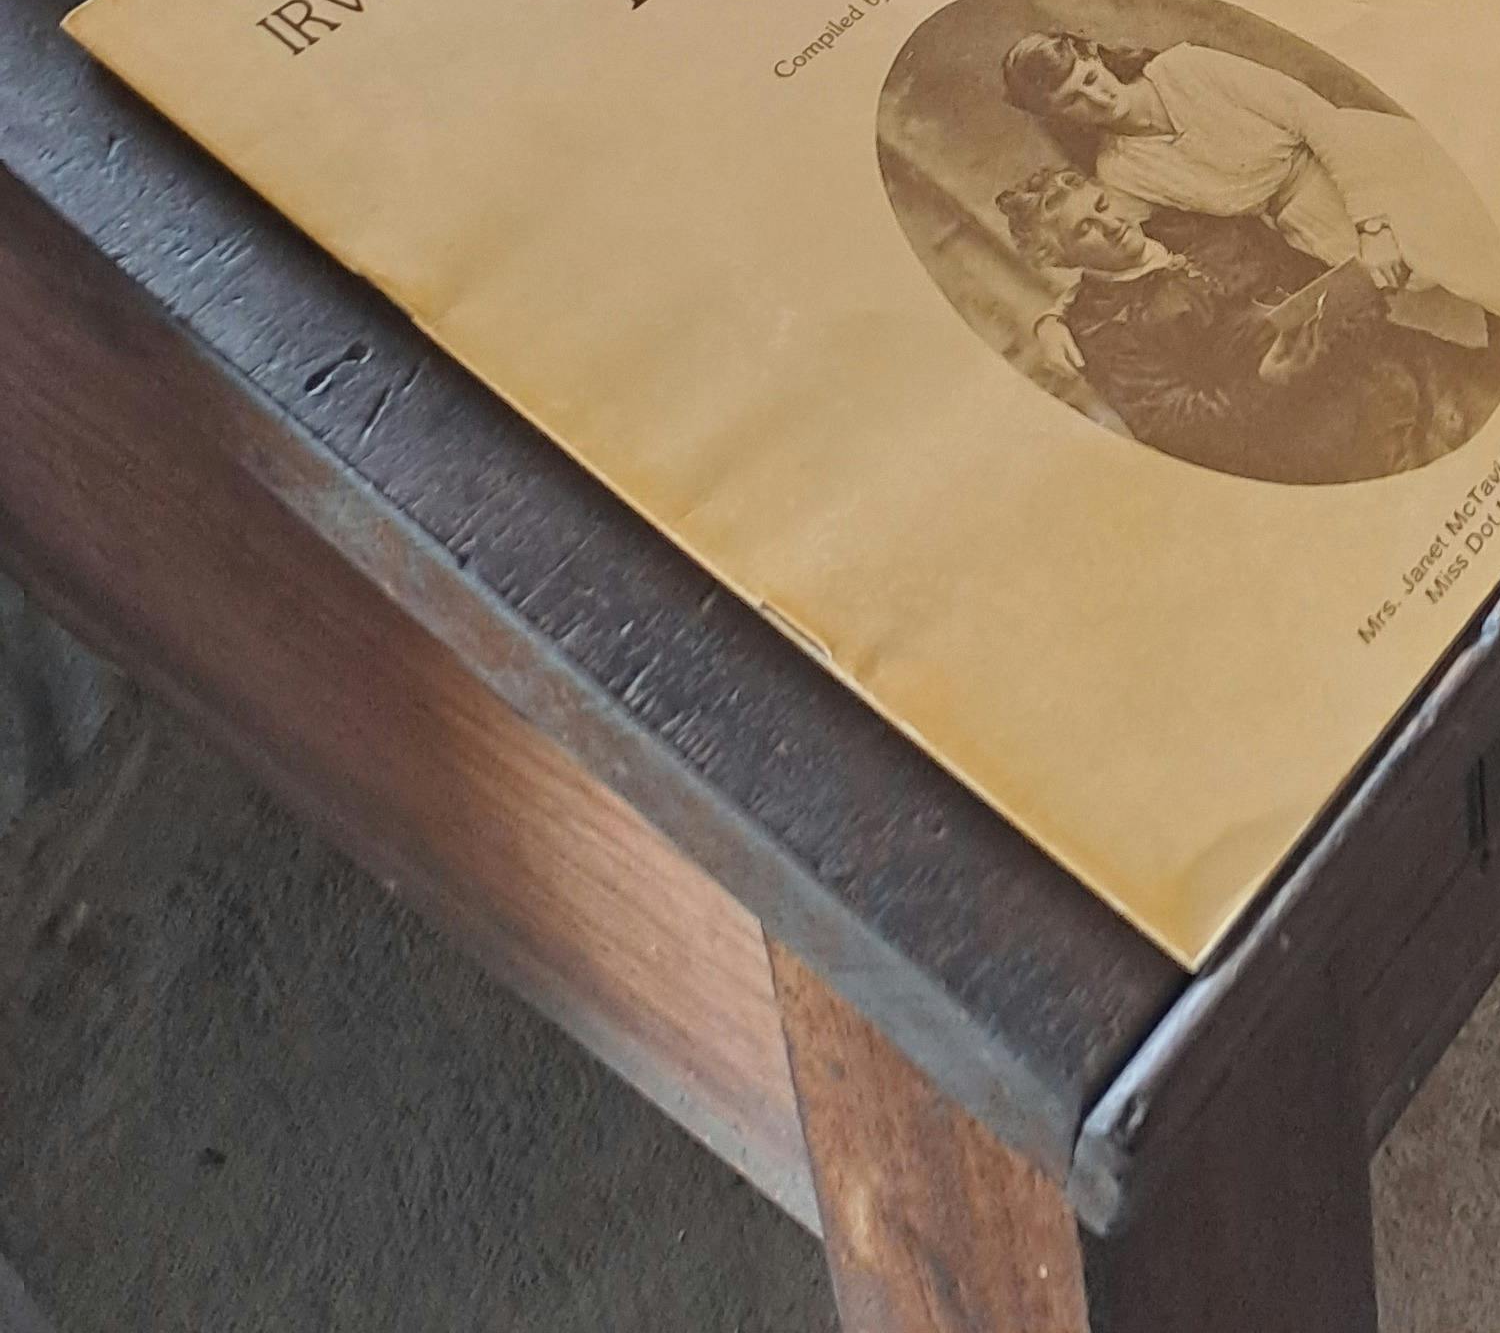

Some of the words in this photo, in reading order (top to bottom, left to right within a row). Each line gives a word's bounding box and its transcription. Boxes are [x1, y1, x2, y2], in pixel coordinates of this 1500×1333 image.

[774, 4, 866, 79] Compiled
[1356, 599, 1403, 646] Mrs.
[1402, 537, 1453, 597] Janet
[1423, 551, 1471, 607] Miss
